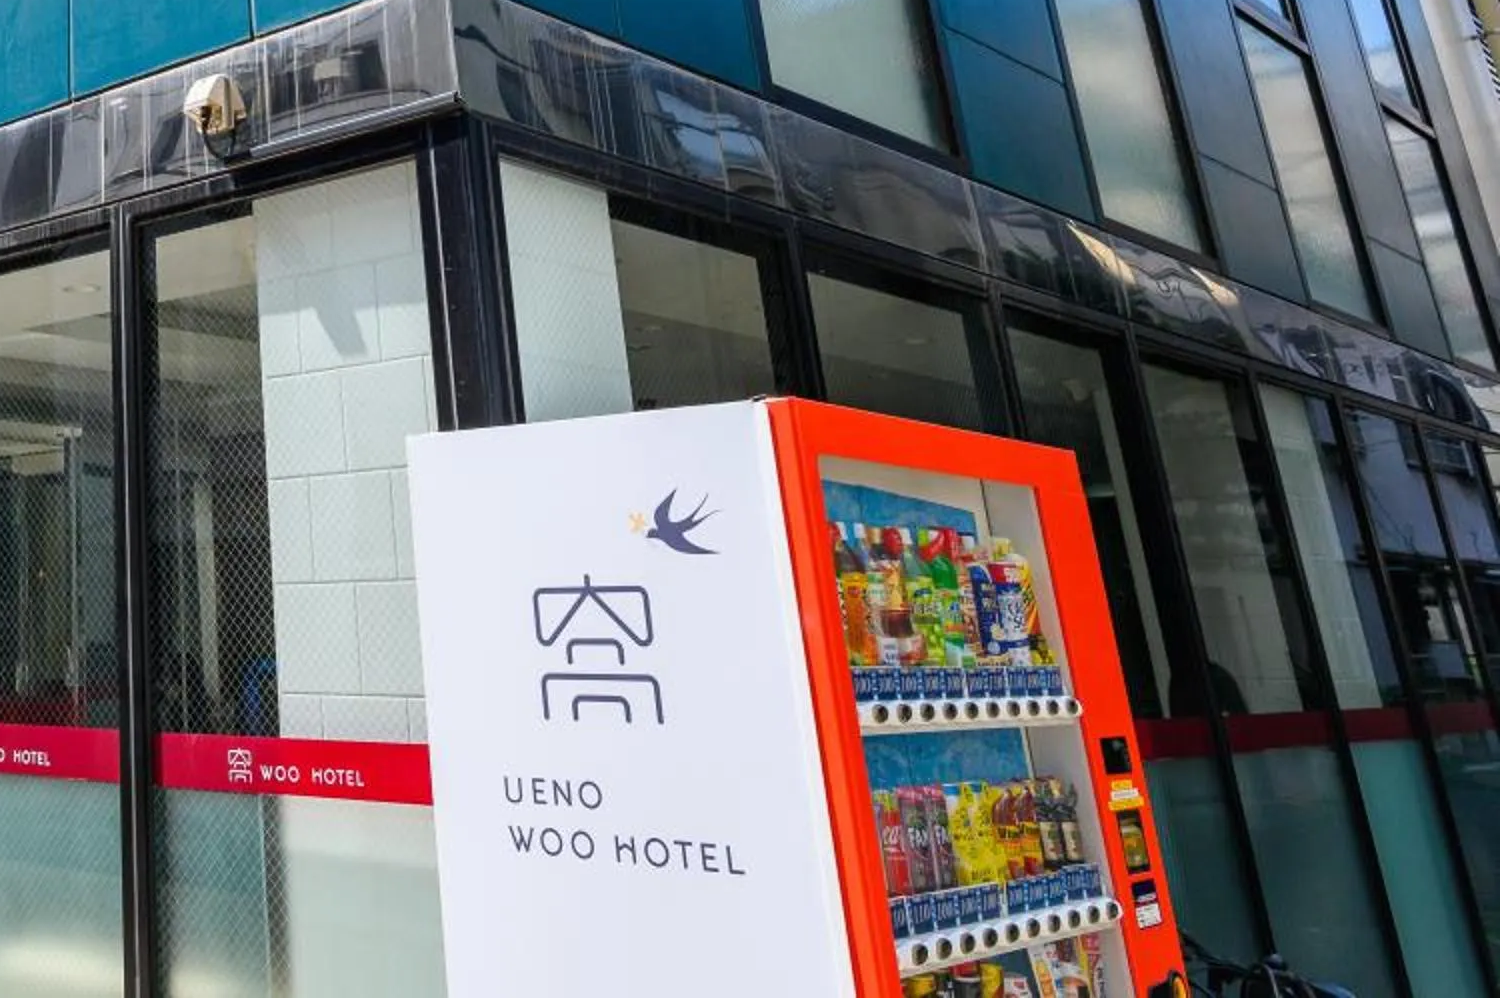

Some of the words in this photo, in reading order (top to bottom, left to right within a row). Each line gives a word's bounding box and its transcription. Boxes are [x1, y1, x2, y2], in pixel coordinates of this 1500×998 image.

[13, 750, 52, 767] HOTEL
[260, 765, 300, 783] WOO
[311, 767, 366, 787] HOTEL
[502, 775, 604, 810] UENO
[508, 825, 596, 860] WOO
[613, 834, 747, 876] HOTEL
